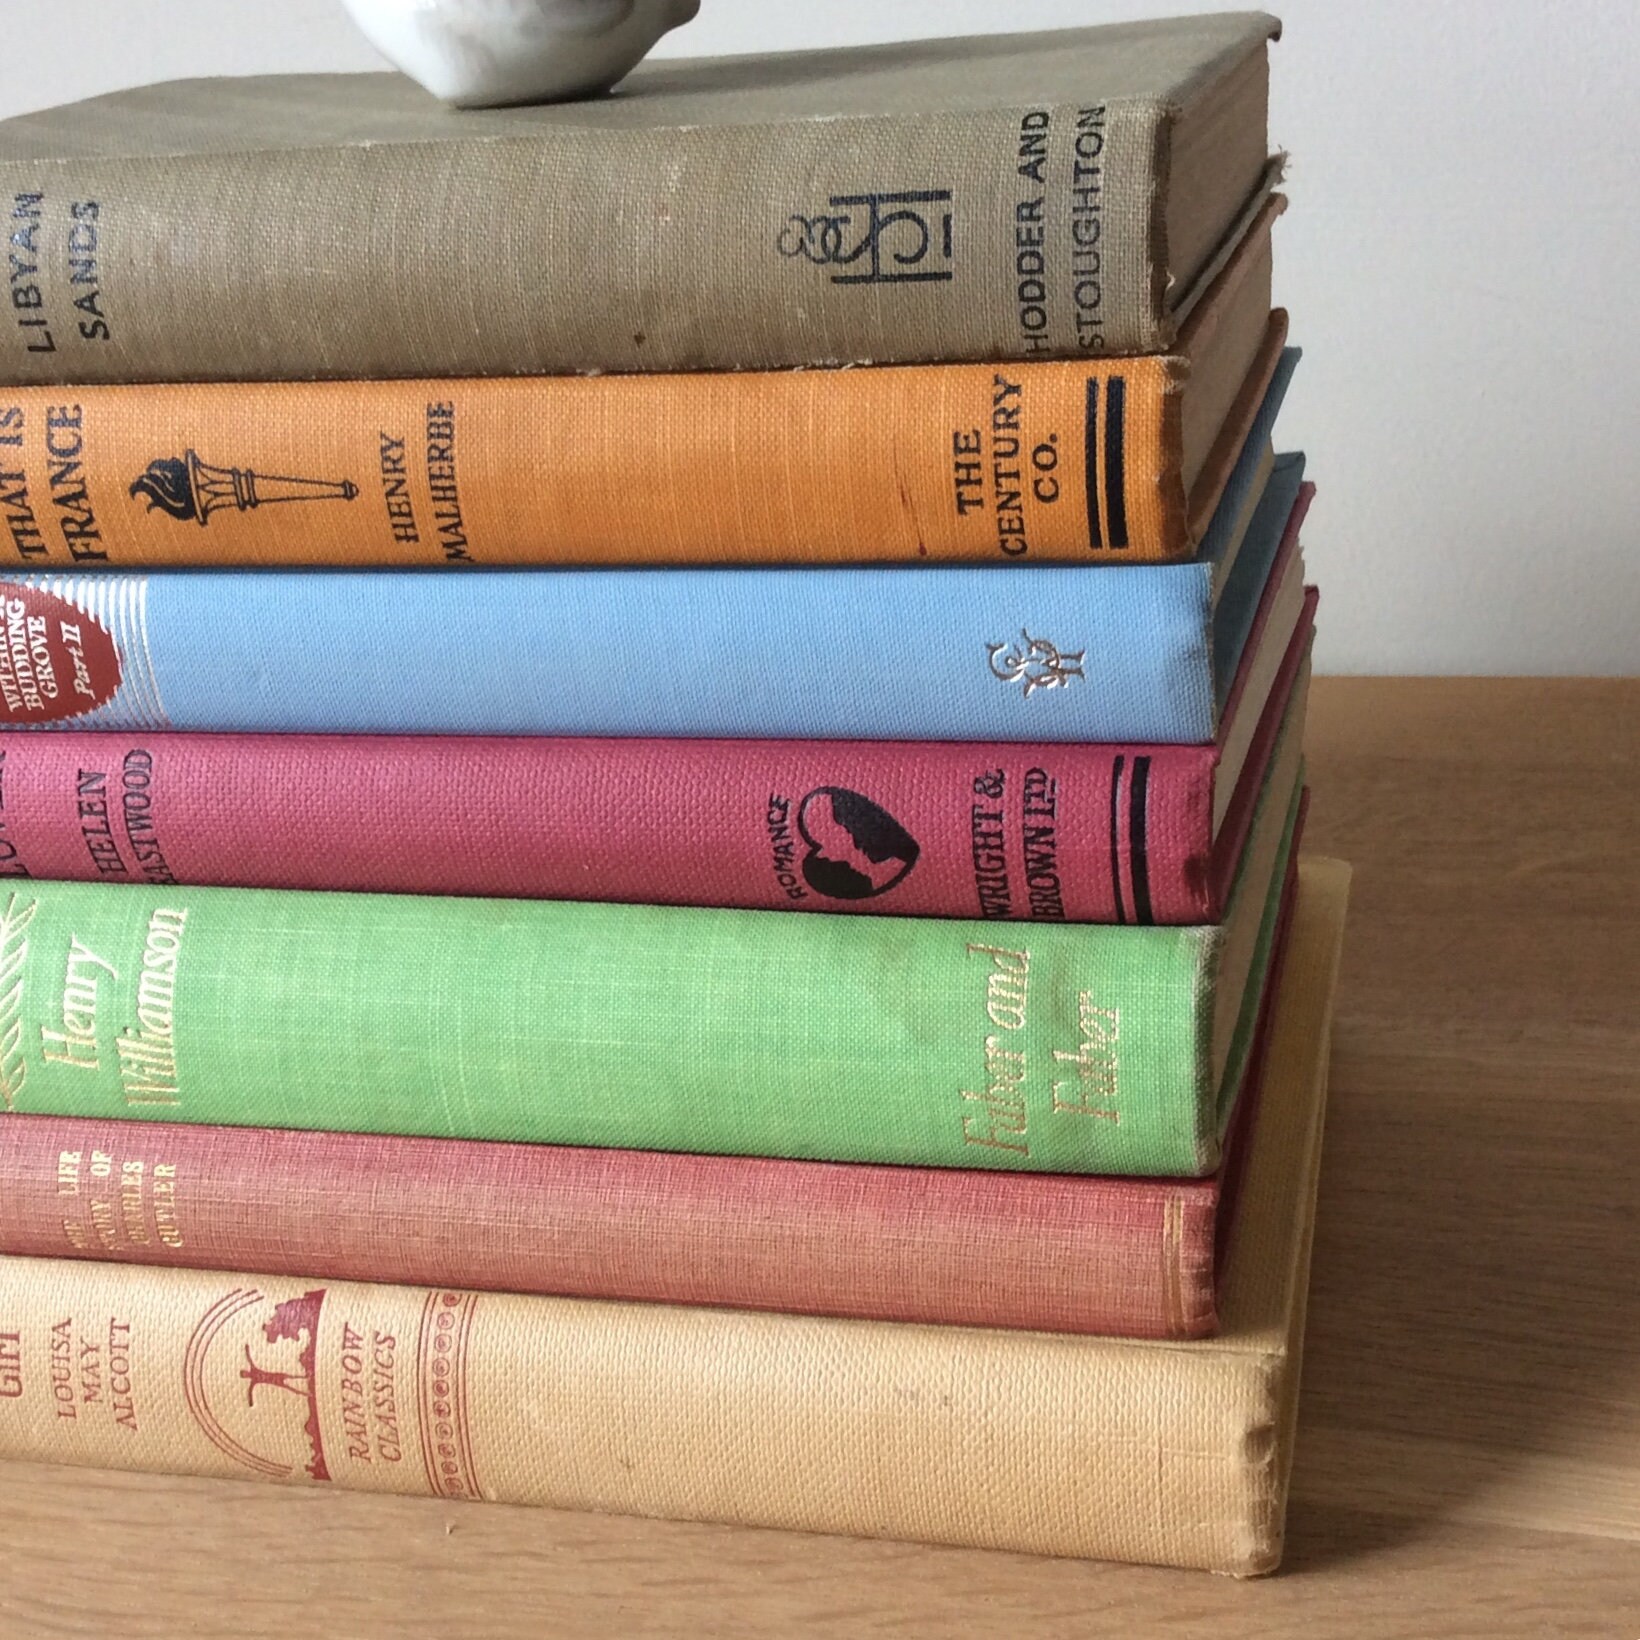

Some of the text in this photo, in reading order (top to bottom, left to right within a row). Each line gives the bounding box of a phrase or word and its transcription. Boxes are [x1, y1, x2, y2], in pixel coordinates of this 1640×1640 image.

[9, 191, 57, 353] LIBYAN
[69, 202, 110, 341] SANDS
[1017, 111, 1050, 354] HODDER AND
[1072, 105, 1106, 352] STOUGHTON
[0, 406, 48, 560] THAT IS
[46, 404, 108, 562] FRANCE
[380, 430, 420, 544] HENRY
[426, 401, 475, 562] MALHERBE
[953, 428, 985, 516] THE
[993, 373, 1028, 556] CENTURY
[1032, 433, 1060, 504] CO.
[6, 598, 45, 711] BUDDING
[27, 616, 58, 698] GROVE
[60, 620, 96, 700] Part II
[78, 768, 129, 875] HELEN
[767, 792, 808, 901] ROMANCE
[971, 768, 1012, 920] WRIGHT &
[1023, 826, 1066, 920] BROWN
[41, 932, 118, 1070] Henry
[116, 907, 188, 1107] Williamson
[960, 943, 1031, 1158] Faber and
[1053, 989, 1121, 1126] Faber
[58, 1150, 82, 1196] LIFE
[90, 1150, 113, 1177] OF
[153, 1163, 184, 1248] CUTLER
[51, 1317, 77, 1420] LOUISA
[80, 1336, 103, 1404] MAY
[109, 1317, 138, 1431] ALCOTT
[340, 1322, 371, 1463] RAINBOW
[373, 1330, 402, 1463] CLASSICS
